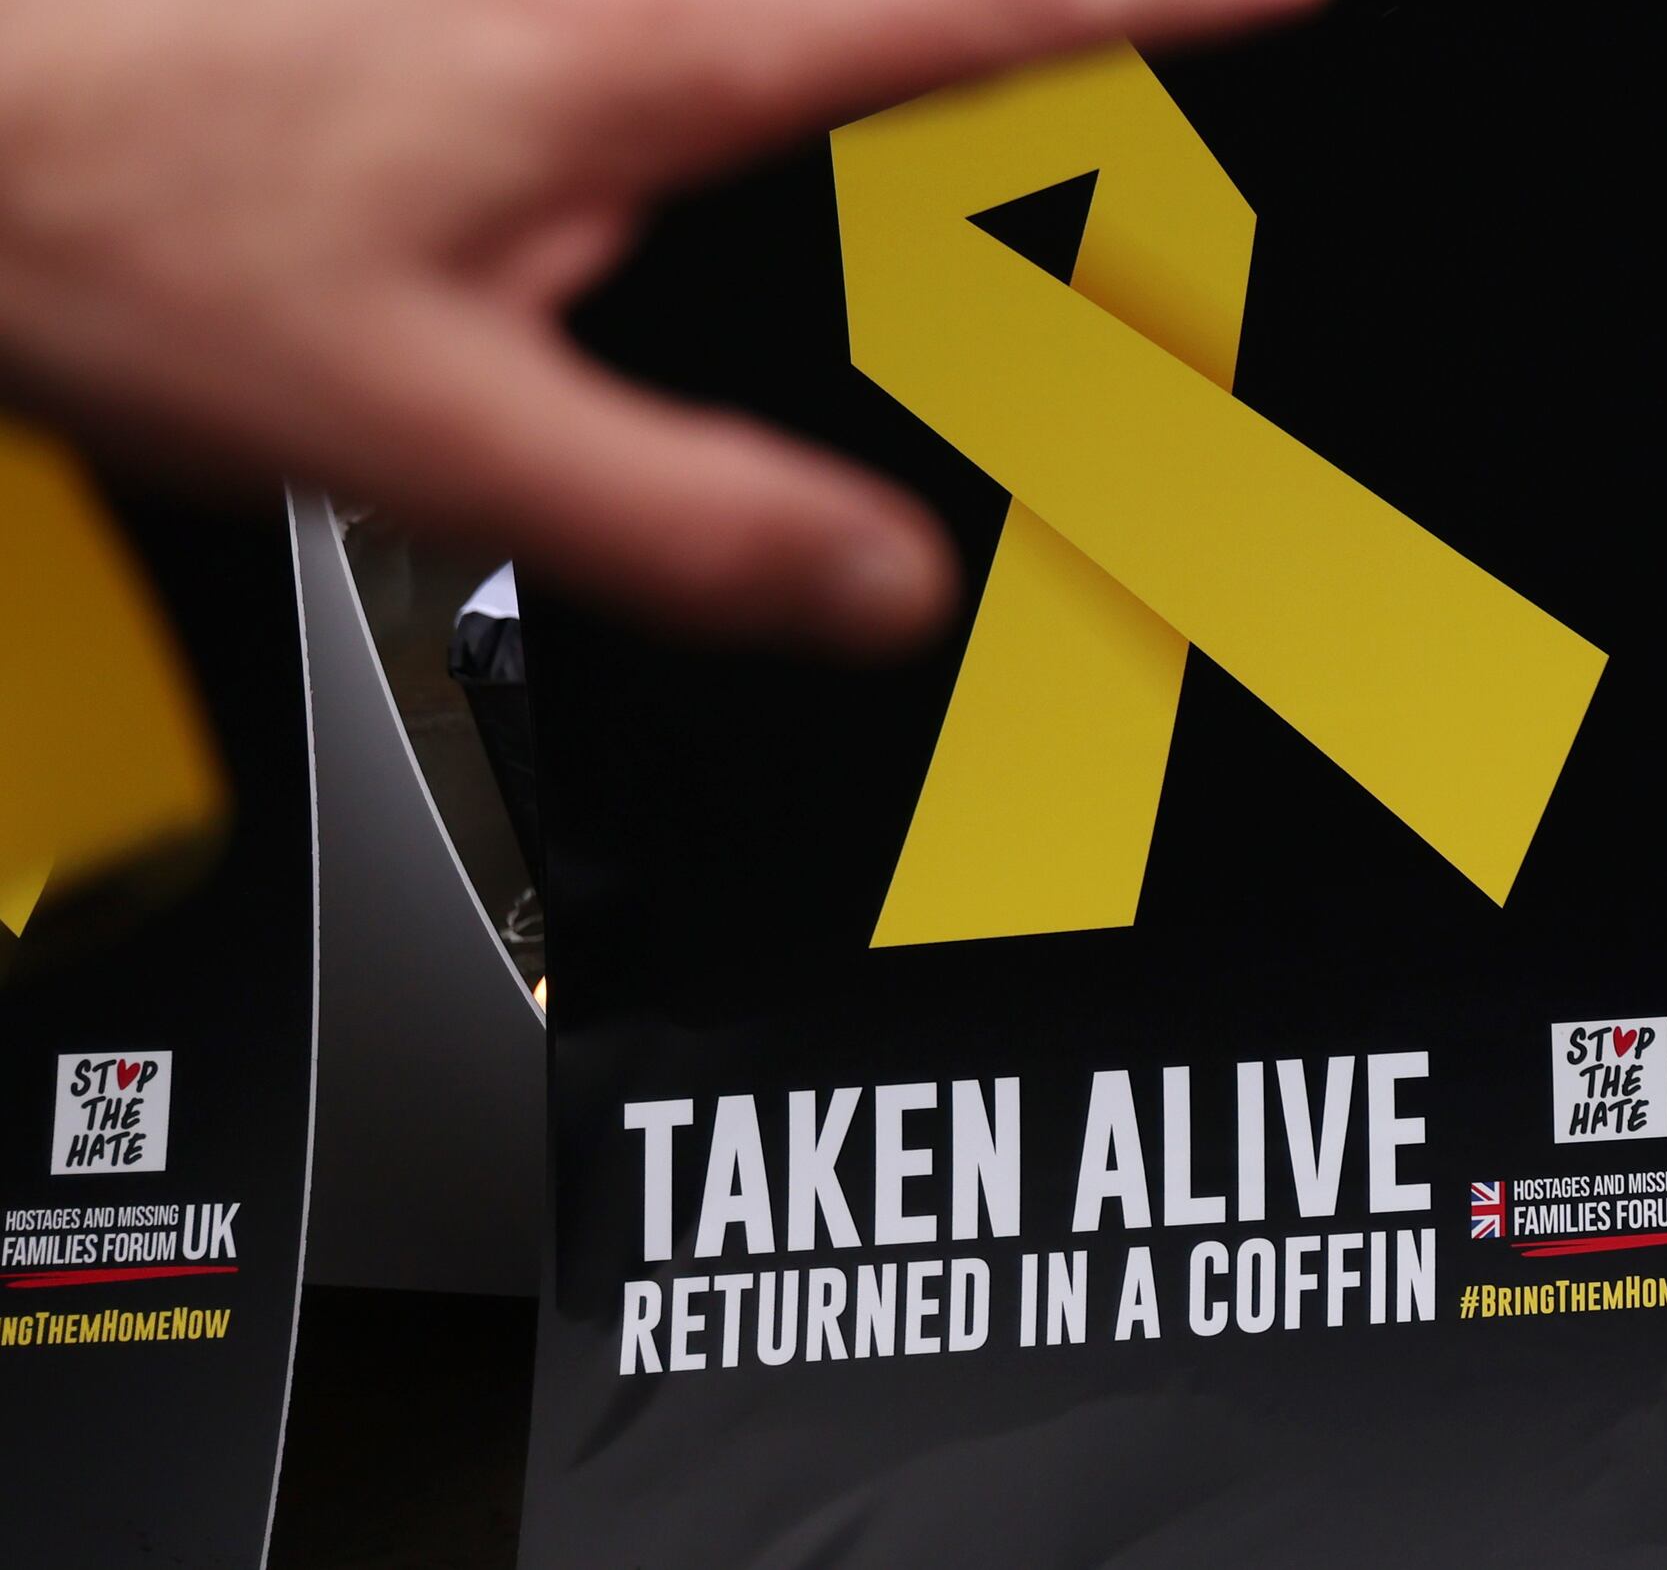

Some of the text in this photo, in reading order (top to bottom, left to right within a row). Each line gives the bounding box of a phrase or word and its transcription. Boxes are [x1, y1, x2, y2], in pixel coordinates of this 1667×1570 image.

[1578, 1063, 1644, 1099] THE
[80, 1095, 145, 1132] THE
[1568, 1097, 1650, 1136] HATE
[65, 1130, 147, 1168] HATE
[623, 1050, 1432, 1262] TAKEN ALIVE
[1513, 1175, 1591, 1201] HOSTAGES
[1593, 1174, 1625, 1196] AND
[5, 1204, 179, 1231] HOSTAGES AND MISSING
[182, 1202, 241, 1261] UK
[1513, 1201, 1611, 1236] FAMILIES
[1, 1231, 177, 1266] FAMILIES FORUM
[619, 1228, 1436, 1376] RETURNED IN A COFFIN
